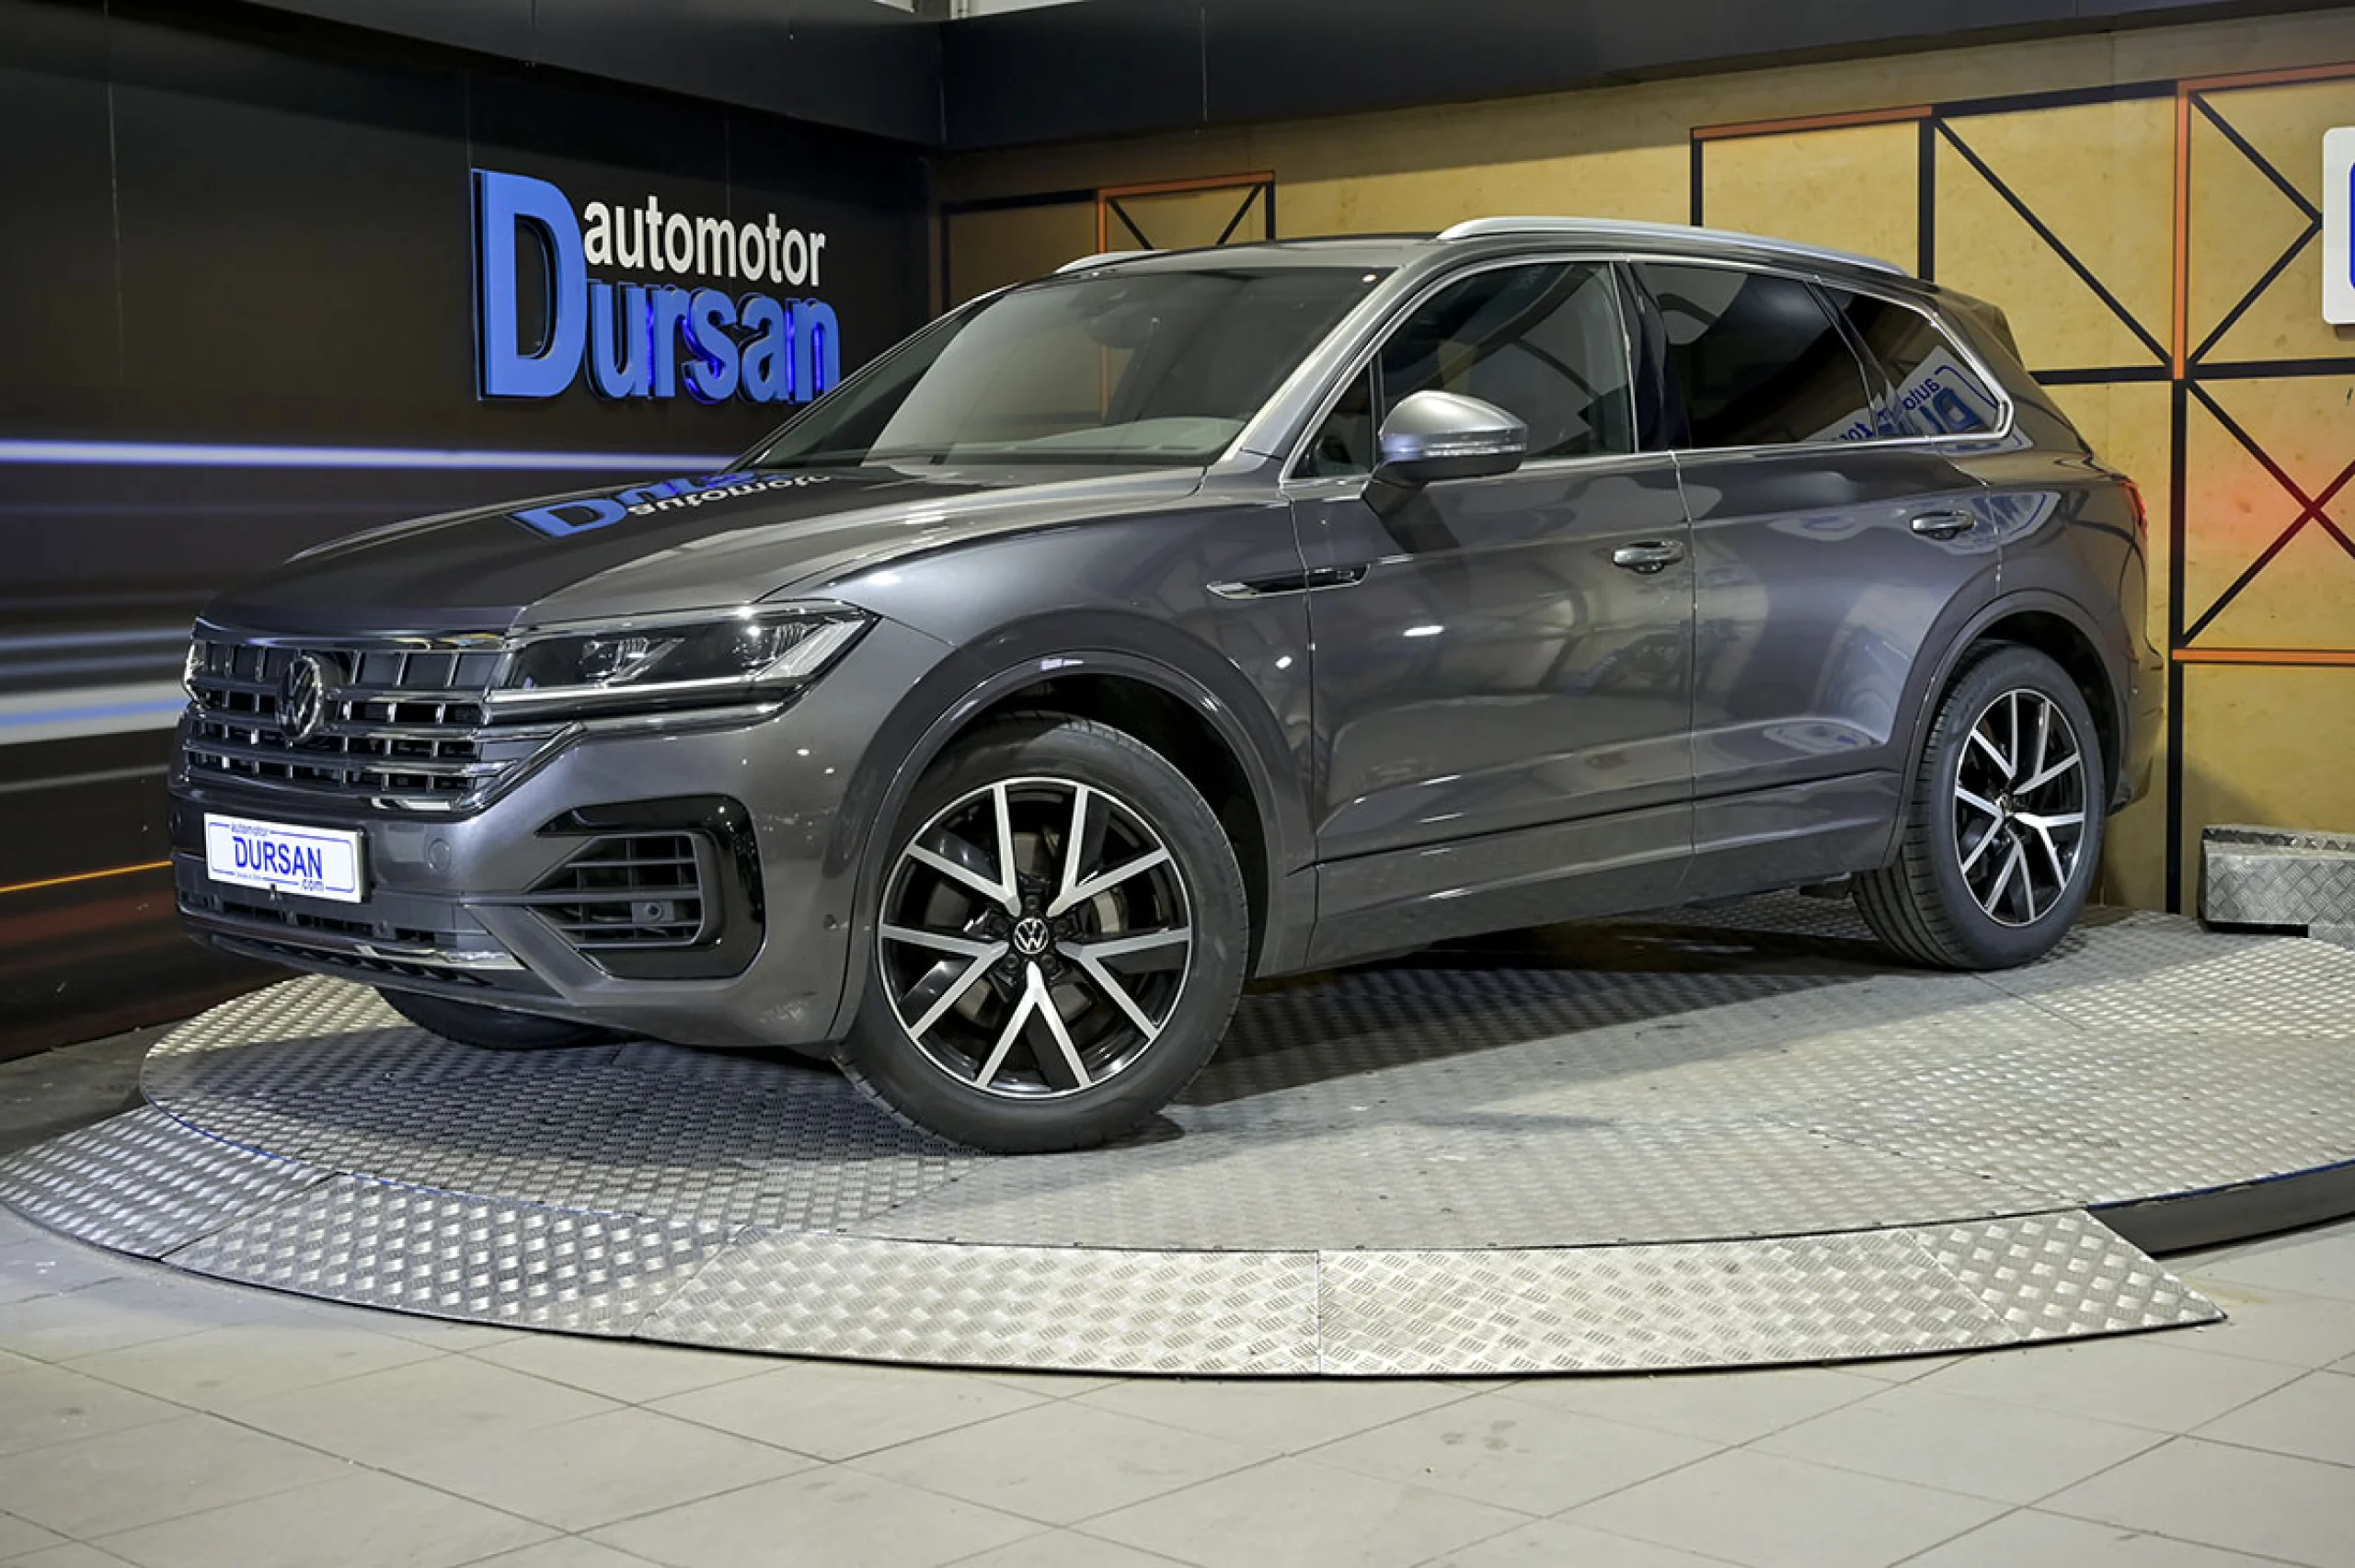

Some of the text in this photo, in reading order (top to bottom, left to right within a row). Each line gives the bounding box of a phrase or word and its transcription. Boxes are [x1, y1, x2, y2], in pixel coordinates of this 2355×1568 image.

[470, 168, 841, 405] Dursan
[584, 195, 825, 287] automotor
[233, 836, 323, 880] DURSAN
